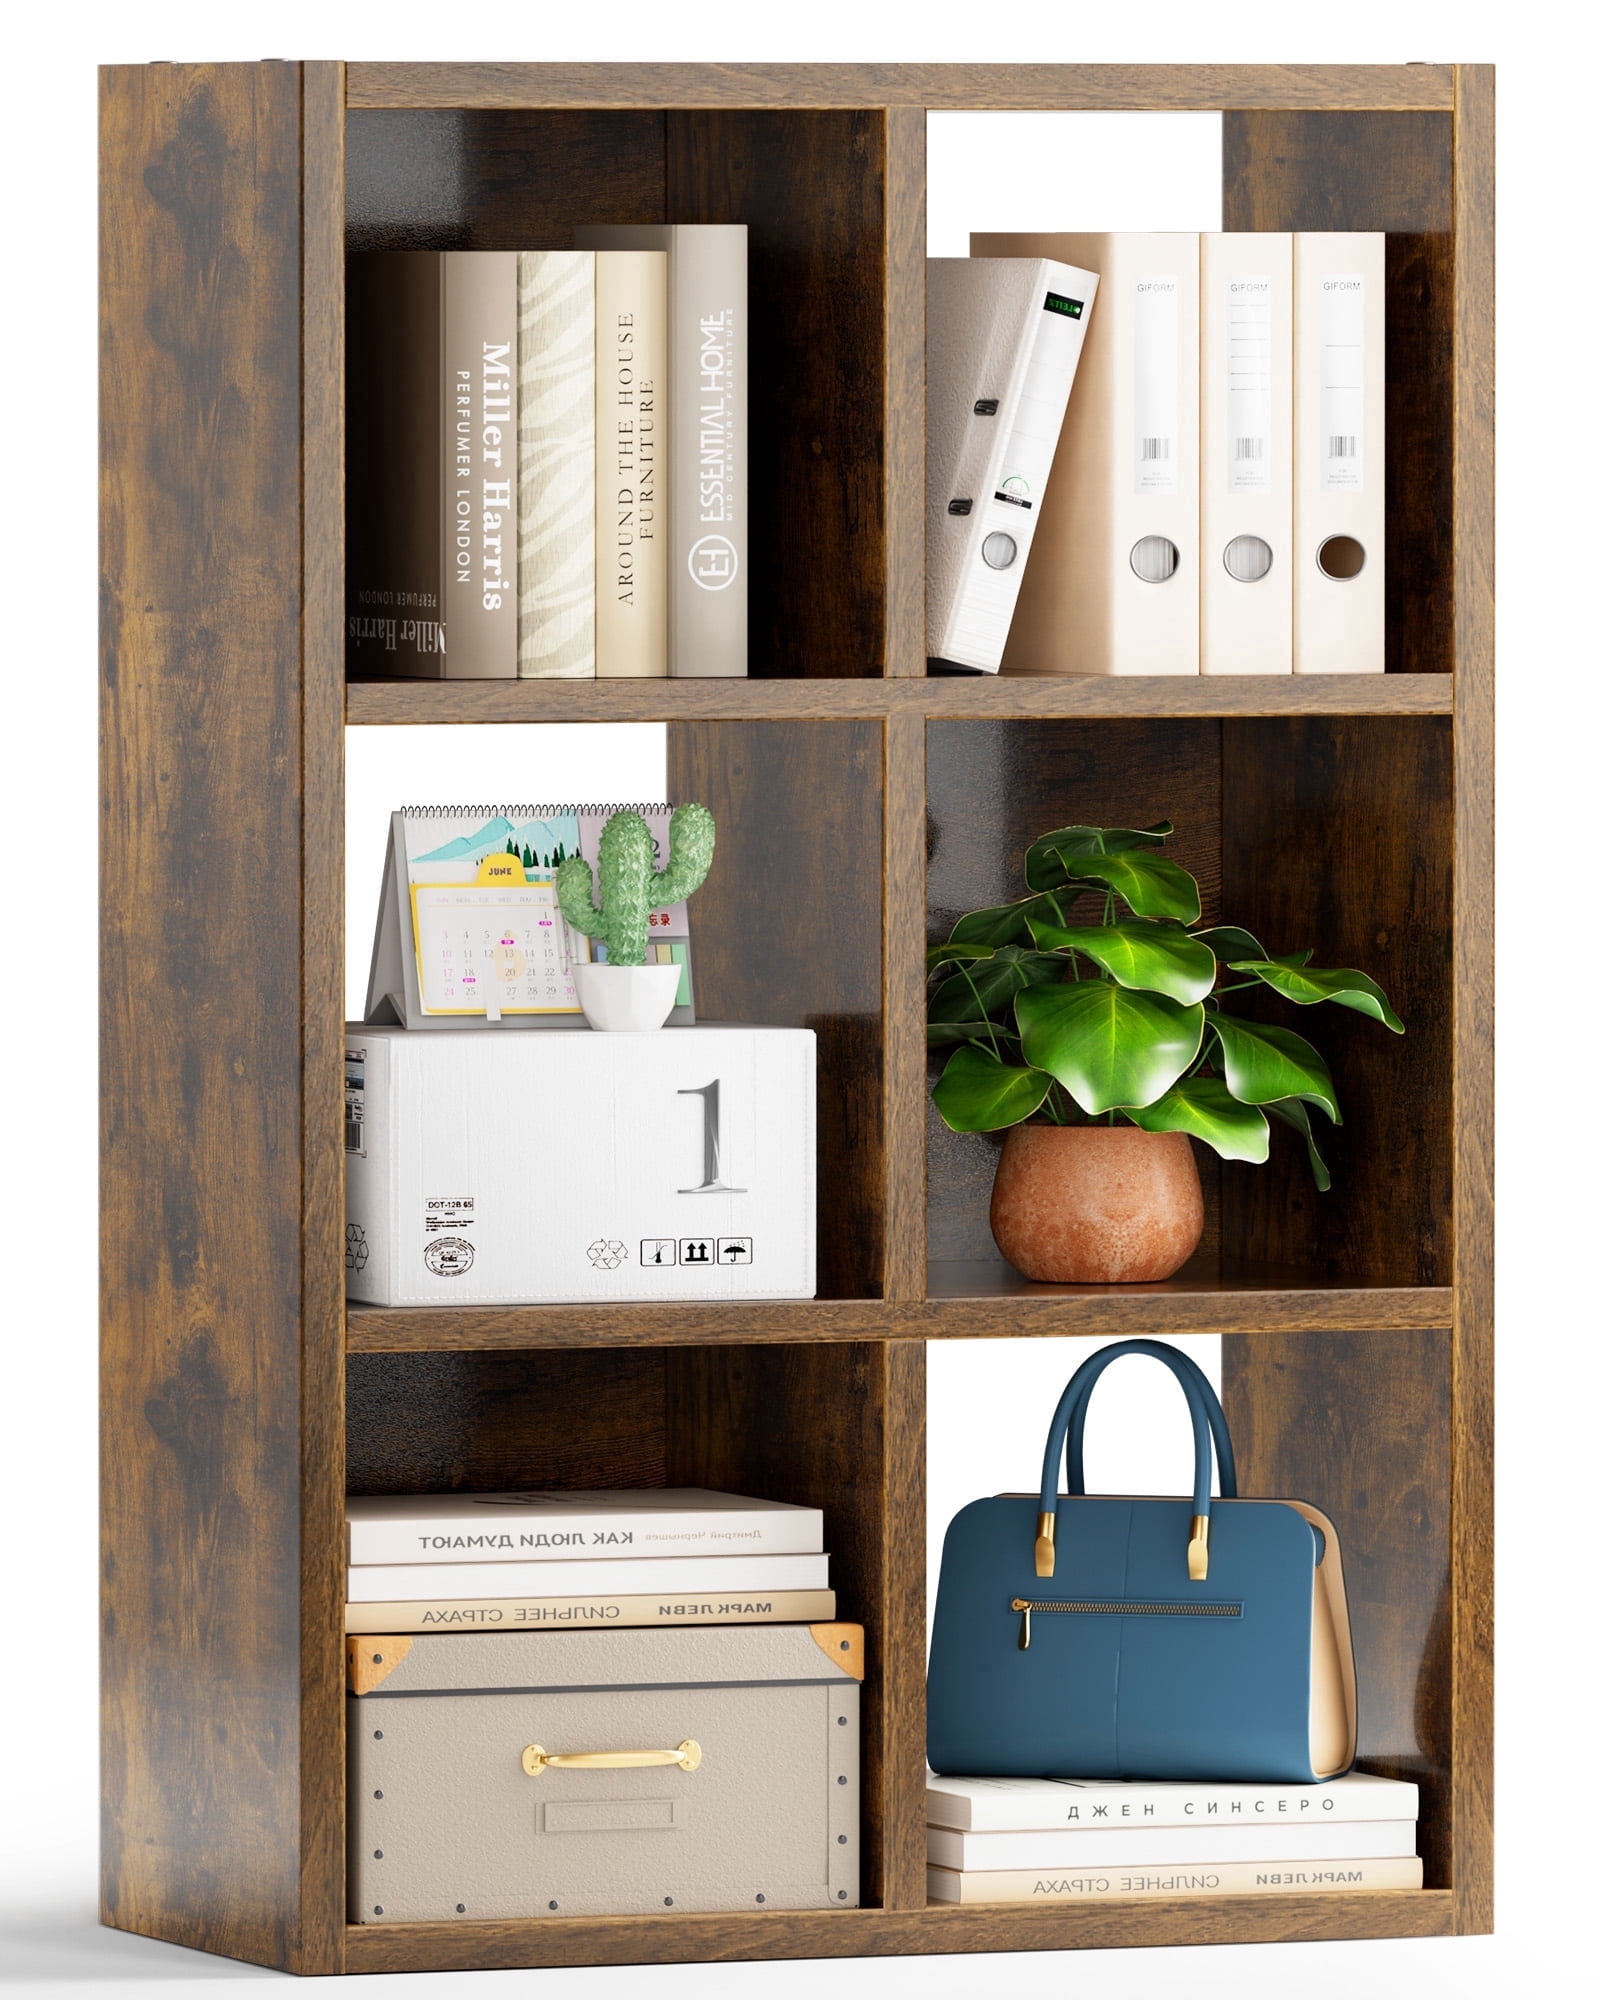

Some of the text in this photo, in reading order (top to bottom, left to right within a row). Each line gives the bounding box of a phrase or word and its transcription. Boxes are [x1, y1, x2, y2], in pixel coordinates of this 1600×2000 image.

[1137, 283, 1174, 293] GIFORM
[1230, 283, 1268, 293] GIFORM
[1323, 281, 1361, 291] GIFORM
[700, 310, 724, 521] ESSENTIAL HOME
[725, 308, 733, 521] MID CENTURY FURNITURE
[618, 313, 633, 605] AROUND THE HOUSE
[640, 380, 653, 540] FURNITURE
[457, 371, 470, 582] PERFUMER LONDON
[483, 341, 511, 610] Miller Harris
[360, 589, 437, 608] PERFUMER LONDON
[349, 616, 397, 650] Harris
[488, 867, 512, 876] JUNE
[543, 911, 549, 920] 1
[463, 930, 469, 939] 4
[484, 930, 490, 939] 5
[504, 930, 511, 938] 6
[524, 930, 530, 938] 7
[543, 930, 550, 938] 8
[442, 949, 452, 958] 10
[464, 949, 473, 958] 11
[484, 949, 493, 958] 12
[504, 949, 514, 958] 13
[525, 949, 535, 958] 14
[544, 949, 554, 958] 15
[443, 968, 453, 977] 17
[464, 968, 475, 977] 18
[505, 968, 516, 976] 20
[526, 968, 536, 976] 21
[544, 968, 555, 976] 22
[444, 986, 576, 996] 24 25 27 28 29 30
[676, 1078, 748, 1194] 1
[1067, 1798, 1335, 1821] ДЖЕН СИНСЕРО
